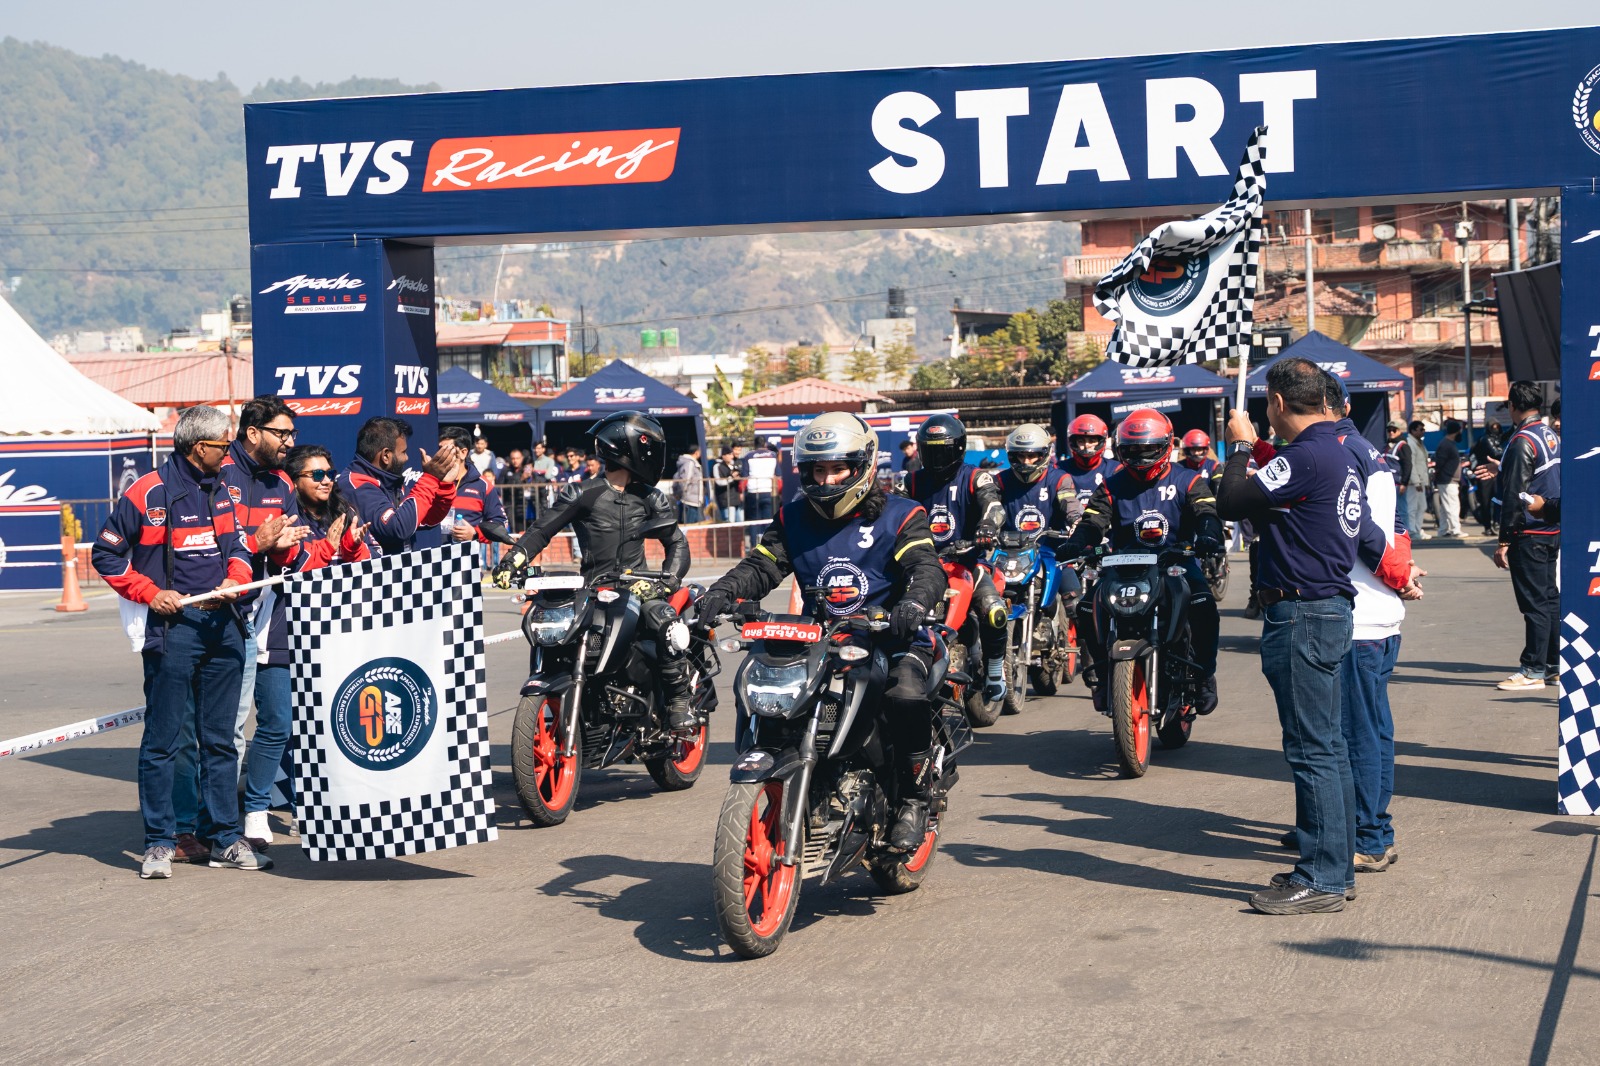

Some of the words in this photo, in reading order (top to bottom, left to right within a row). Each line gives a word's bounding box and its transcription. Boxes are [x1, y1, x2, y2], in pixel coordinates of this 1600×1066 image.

[1586, 68, 1600, 86] APAC
[868, 70, 1317, 194] START
[265, 139, 414, 200] TVS
[432, 140, 676, 188] Racing
[258, 272, 366, 296] Apache
[387, 274, 430, 294] Apache
[287, 294, 367, 304] SERIES
[1140, 294, 1158, 307] RACING
[1158, 279, 1193, 308] CHAMPIONSHIP
[1120, 367, 1172, 379] TVS
[1315, 362, 1347, 372] VS
[275, 365, 362, 396] TVS
[394, 364, 429, 395] TVS
[594, 387, 644, 398] TVS
[397, 400, 429, 413] Racing
[810, 431, 832, 440] KYT
[949, 486, 958, 501] 1
[1039, 488, 1048, 502] 5
[1158, 485, 1176, 501] 19
[1142, 520, 1160, 529] ARE
[857, 526, 874, 548] 3
[828, 575, 854, 586] ARE
[1120, 587, 1137, 597] 19
[344, 678, 364, 700] ULTIMATE
[400, 675, 414, 693] APACHE
[338, 700, 346, 722] RACING
[384, 690, 402, 734] ARE
[340, 722, 366, 756] CHAMPIONSHIP
[402, 714, 421, 747] EXPERIENCE
[744, 752, 765, 761] 3
[915, 758, 930, 786] SPEED
